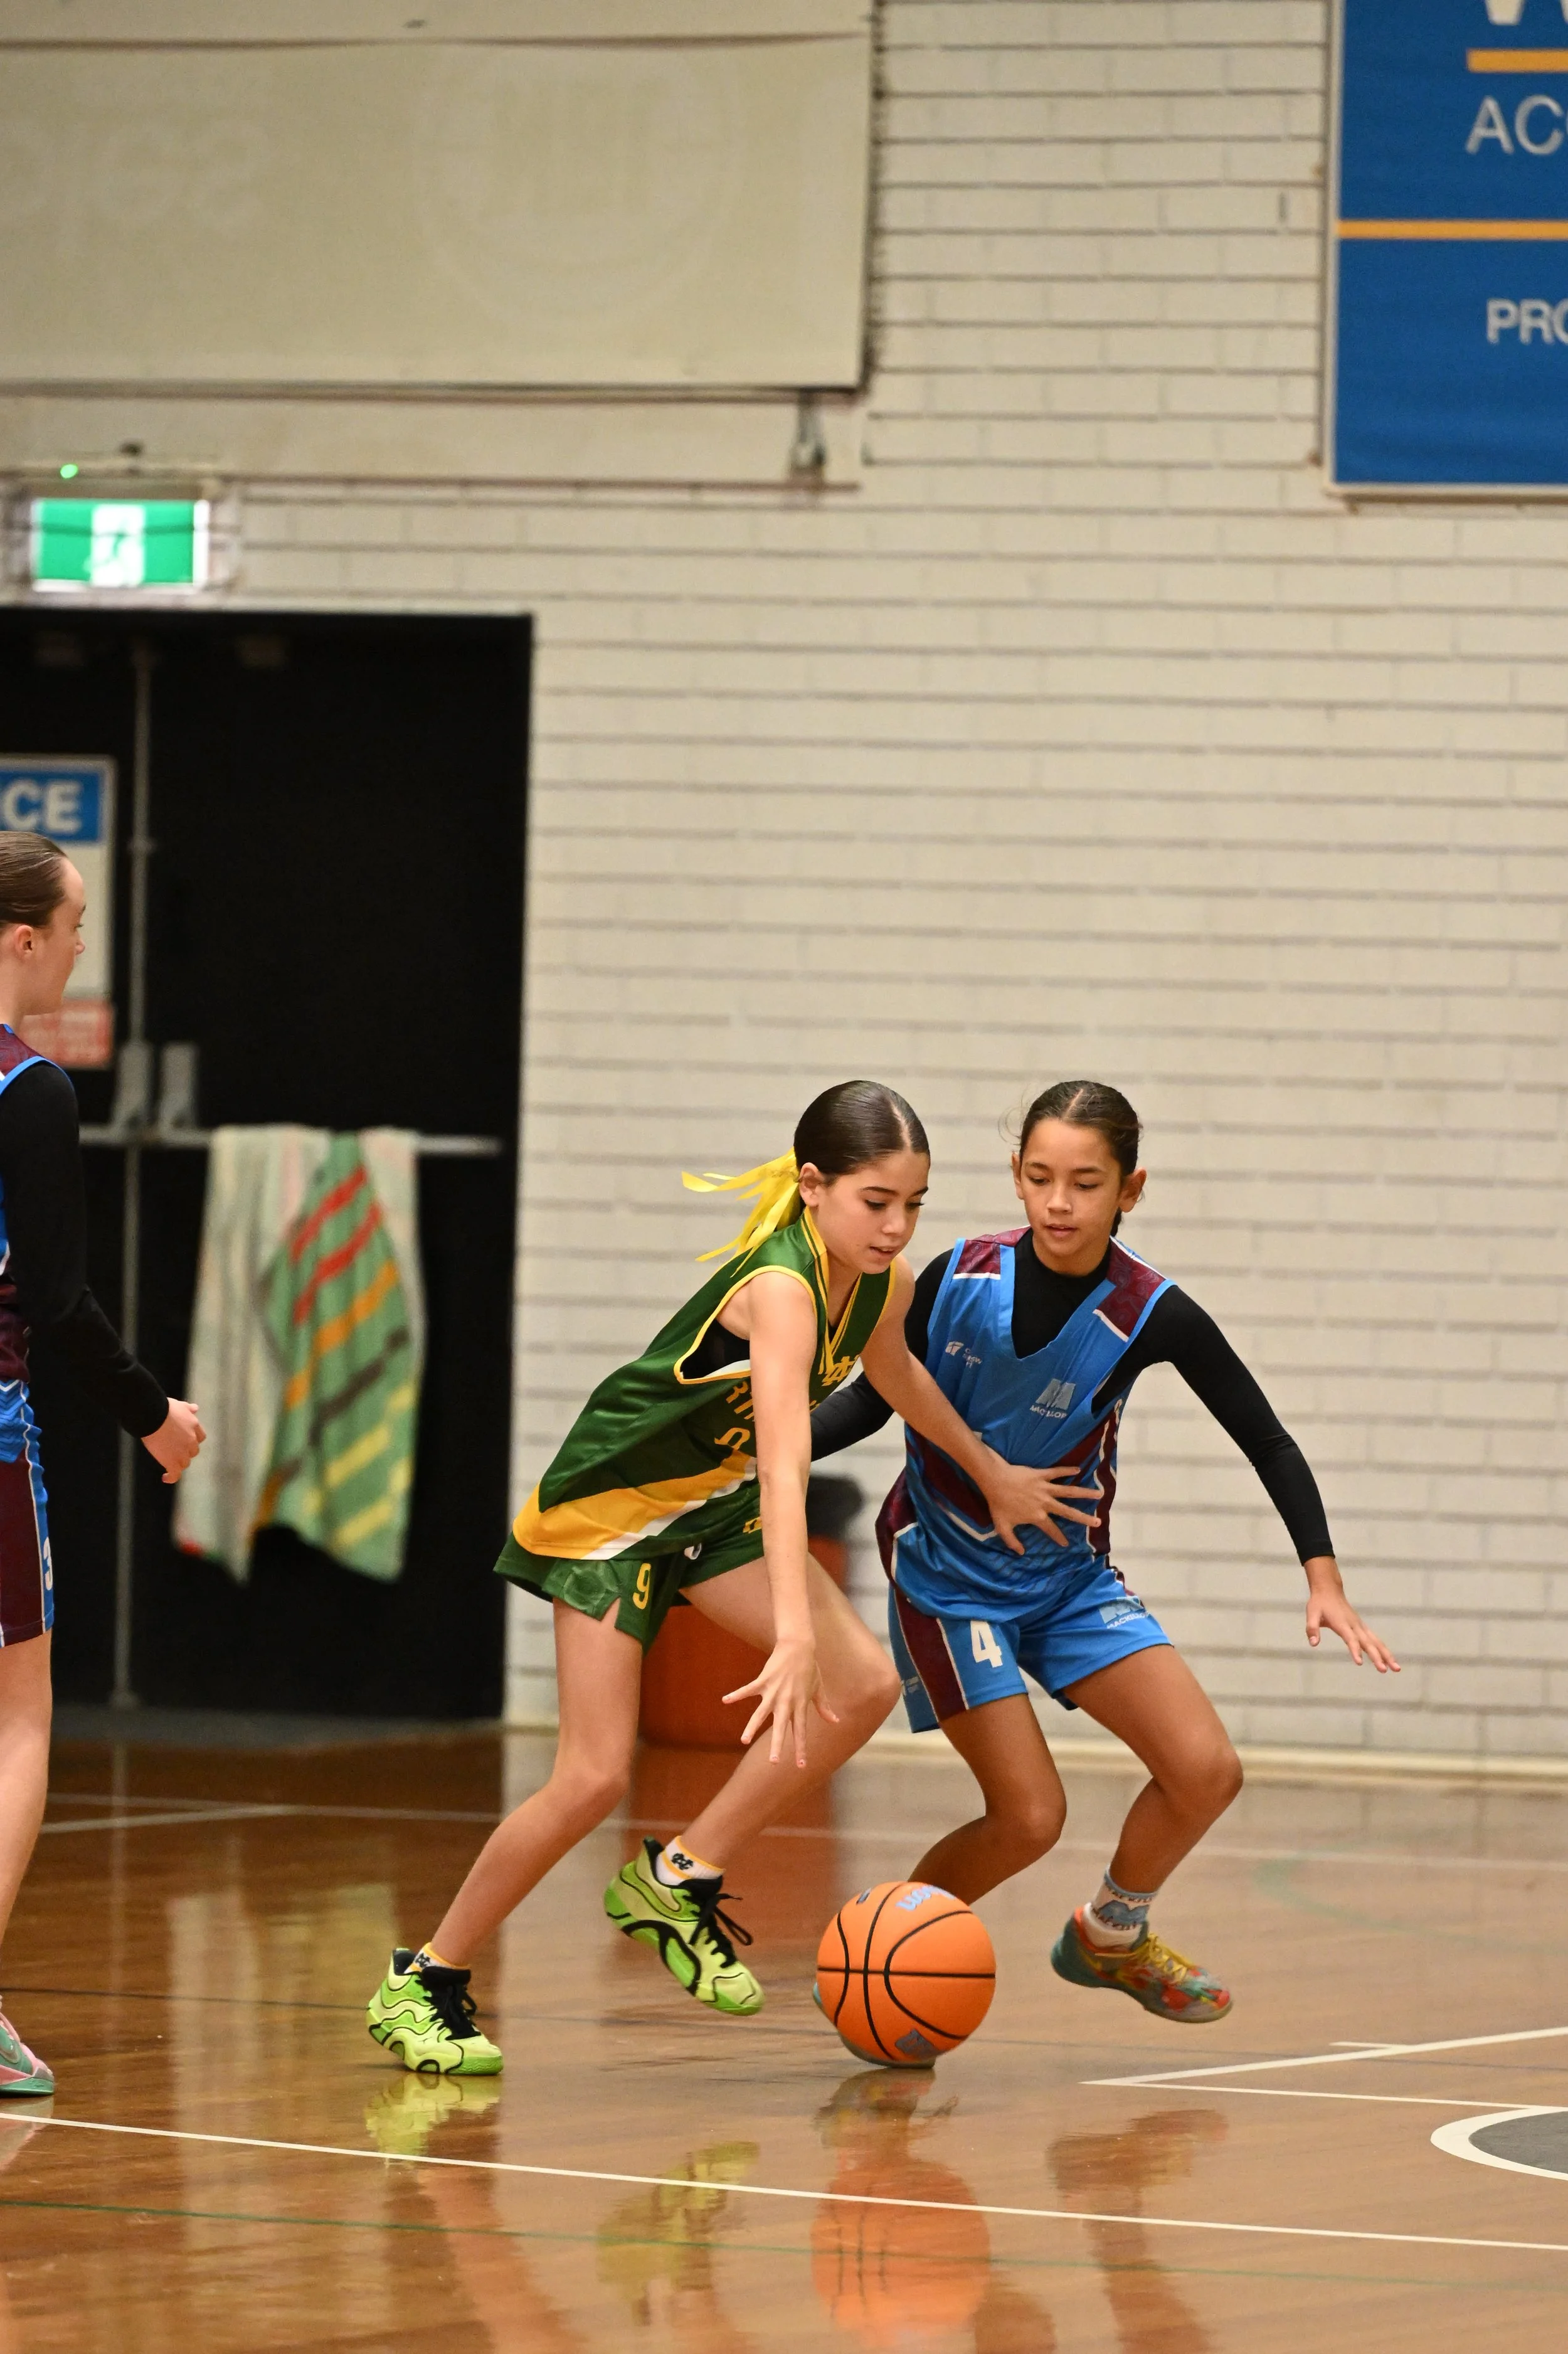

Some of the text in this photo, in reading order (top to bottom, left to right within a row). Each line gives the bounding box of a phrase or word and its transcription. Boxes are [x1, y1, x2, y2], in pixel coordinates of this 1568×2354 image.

[1466, 95, 1568, 154] AC
[1, 779, 83, 834] CE
[633, 1563, 651, 1609] 9
[970, 1620, 1003, 1668] 4
